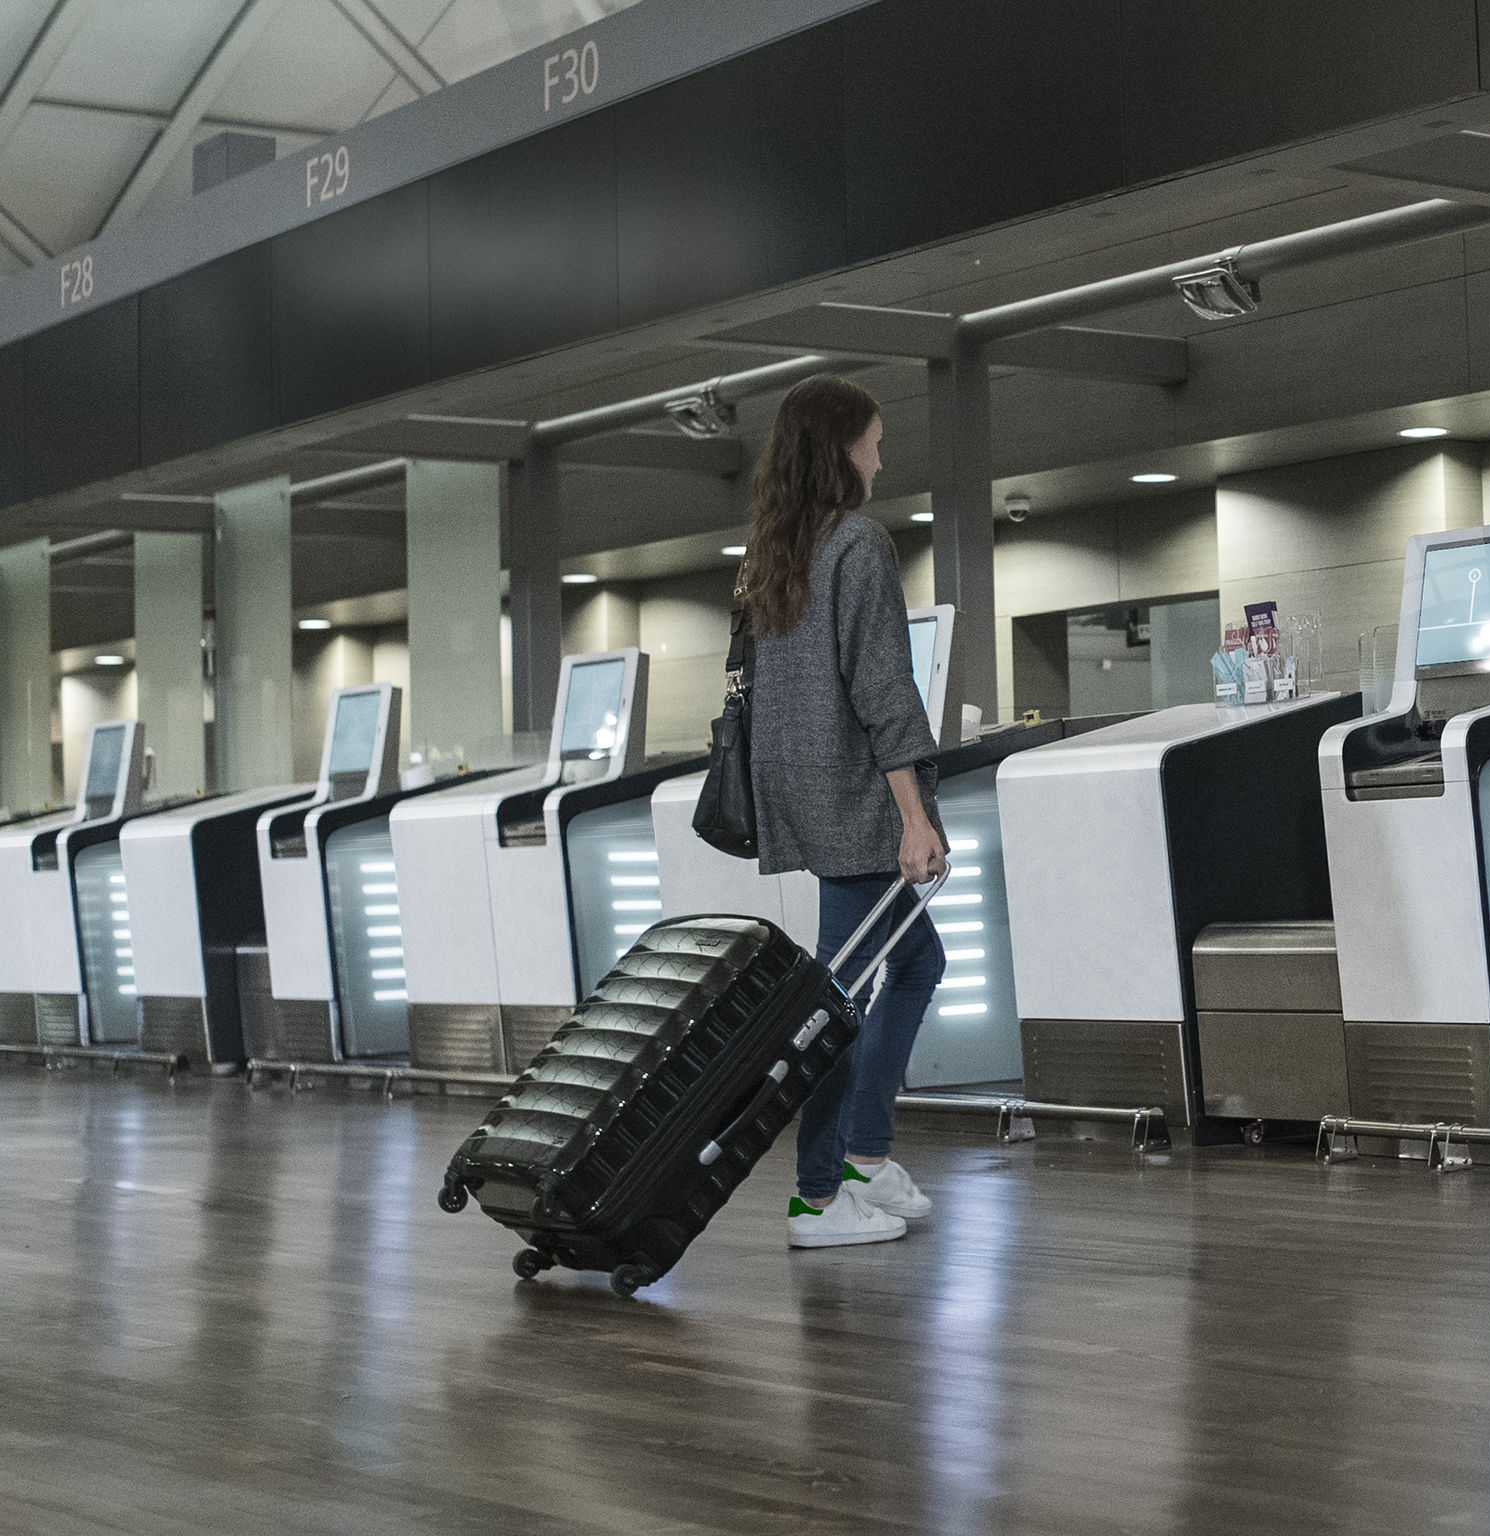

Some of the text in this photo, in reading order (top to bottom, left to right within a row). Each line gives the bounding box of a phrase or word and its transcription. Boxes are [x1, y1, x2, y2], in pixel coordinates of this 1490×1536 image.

[544, 41, 599, 112] F30
[306, 146, 349, 208] F29
[61, 255, 93, 308] F28
